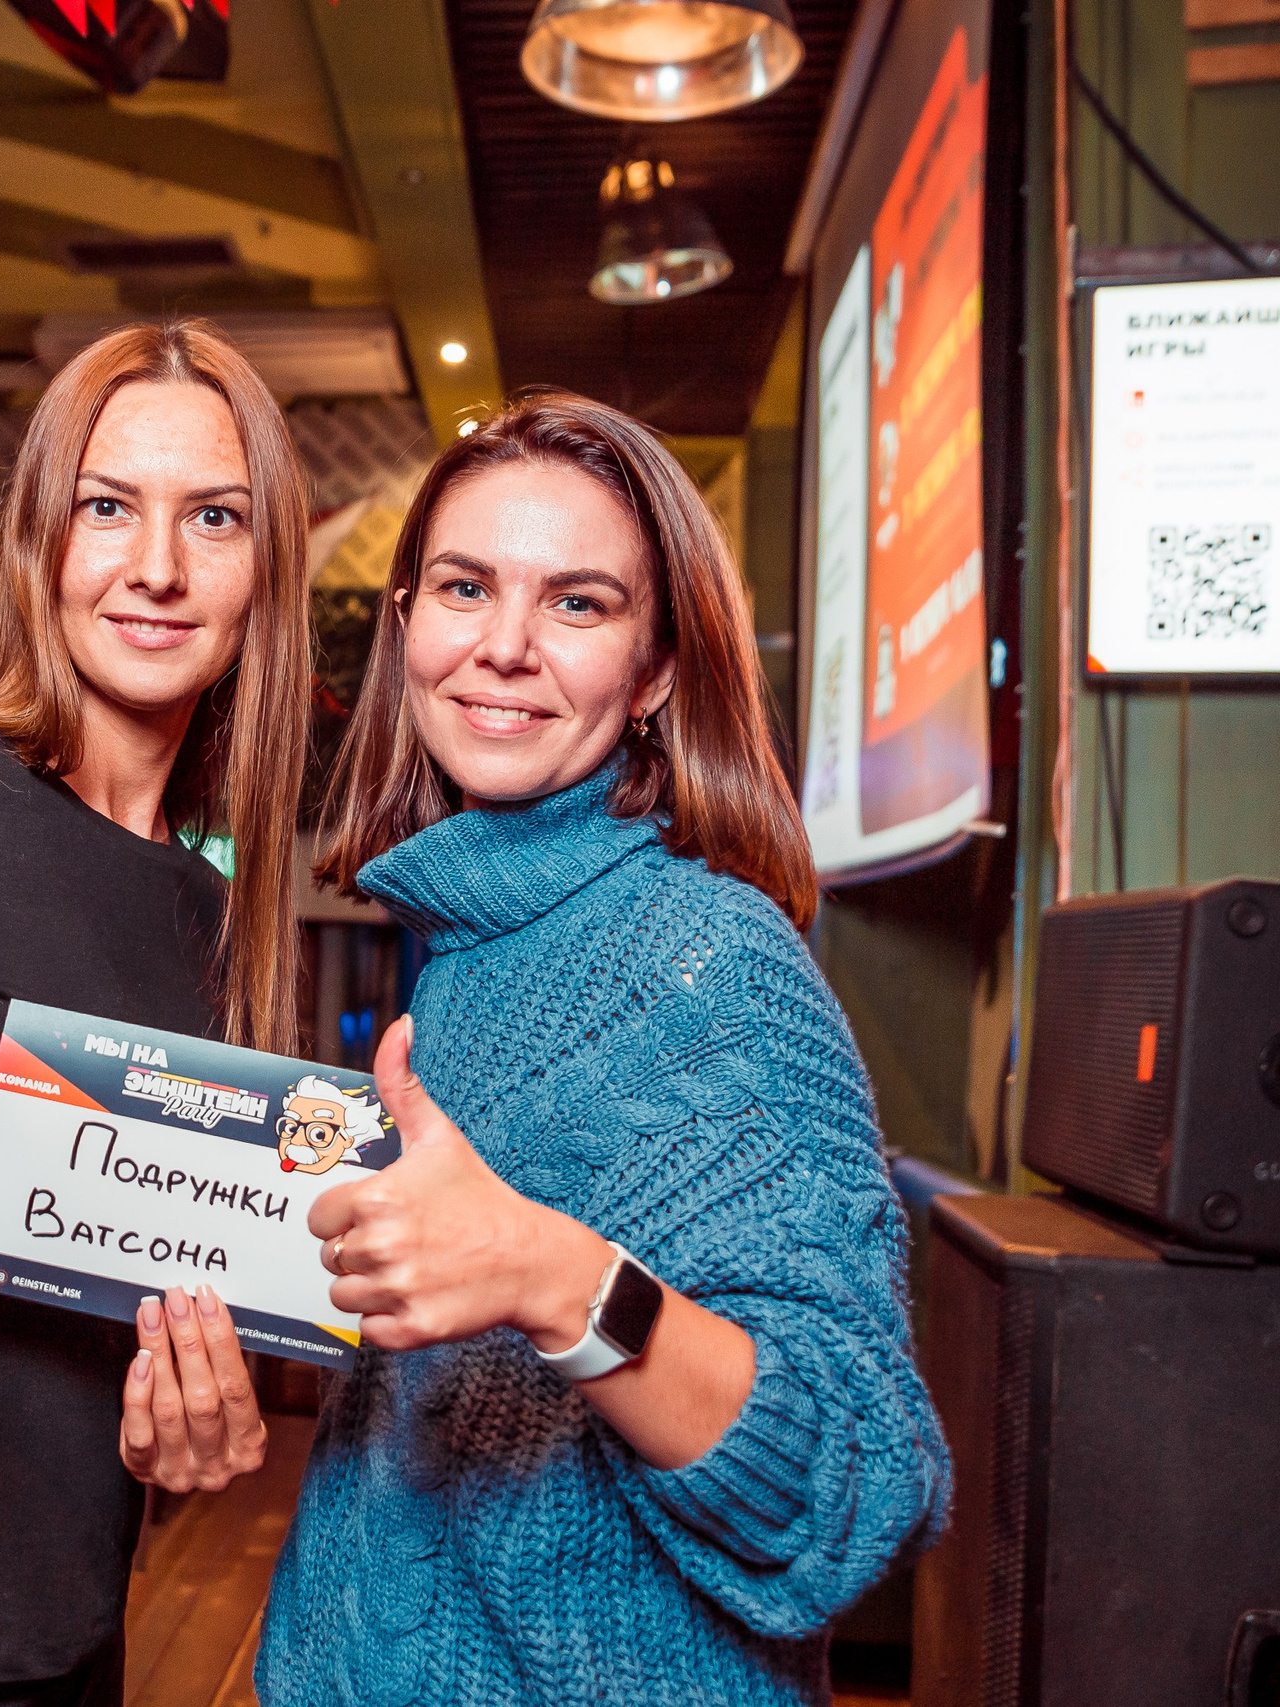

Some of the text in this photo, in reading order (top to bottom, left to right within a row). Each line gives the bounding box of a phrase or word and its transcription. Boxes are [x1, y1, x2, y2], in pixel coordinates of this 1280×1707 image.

[1127, 340, 1206, 357] ИГРЫ
[83, 1033, 169, 1069] МЫ НА
[123, 1070, 269, 1120] ЭЙНШТЕЙН
[161, 1095, 223, 1129] Party
[11, 1275, 82, 1300] @EINSTEIN_NSK
[234, 1326, 344, 1357] ШТЕЙНNSK #EINSTEINPARTY
